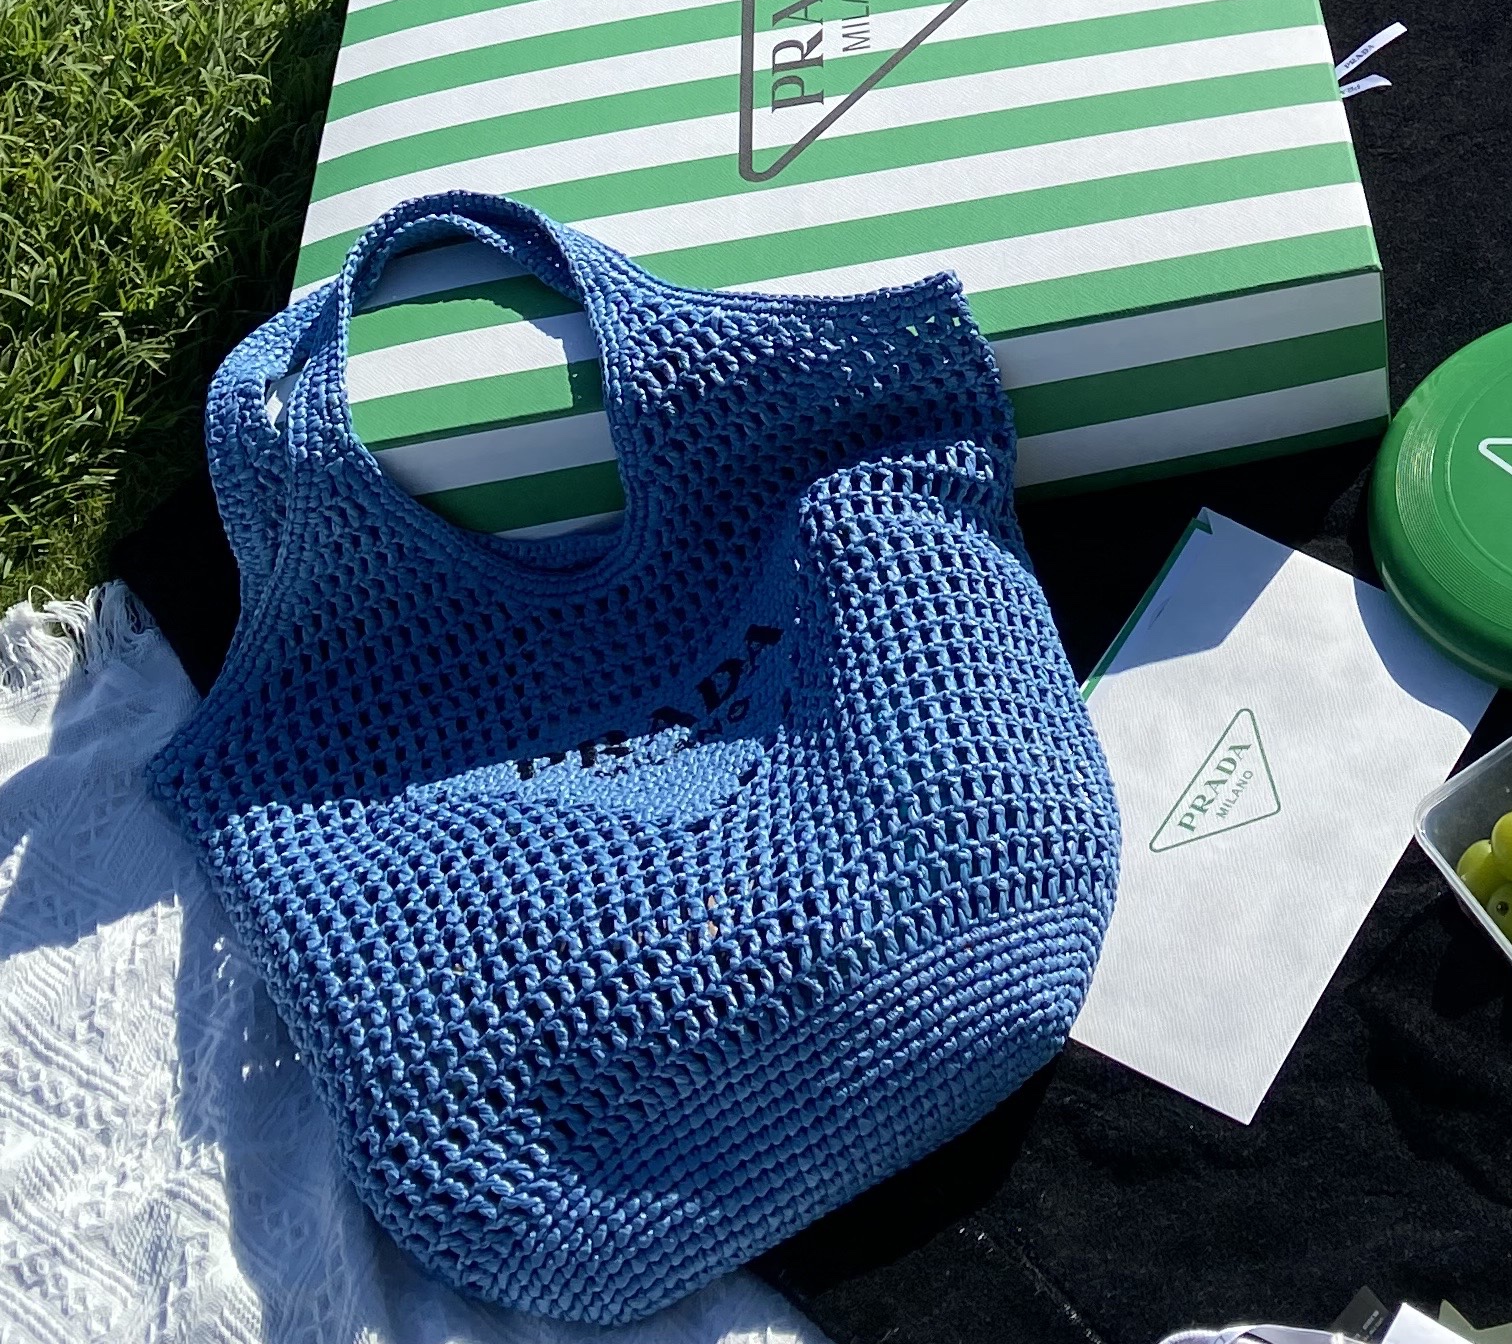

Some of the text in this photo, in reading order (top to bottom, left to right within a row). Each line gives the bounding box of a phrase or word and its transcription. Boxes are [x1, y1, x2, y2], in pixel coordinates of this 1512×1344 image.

[1343, 44, 1375, 69] PRADA
[1176, 742, 1253, 833] PRADA
[1215, 769, 1254, 820] MILANO
